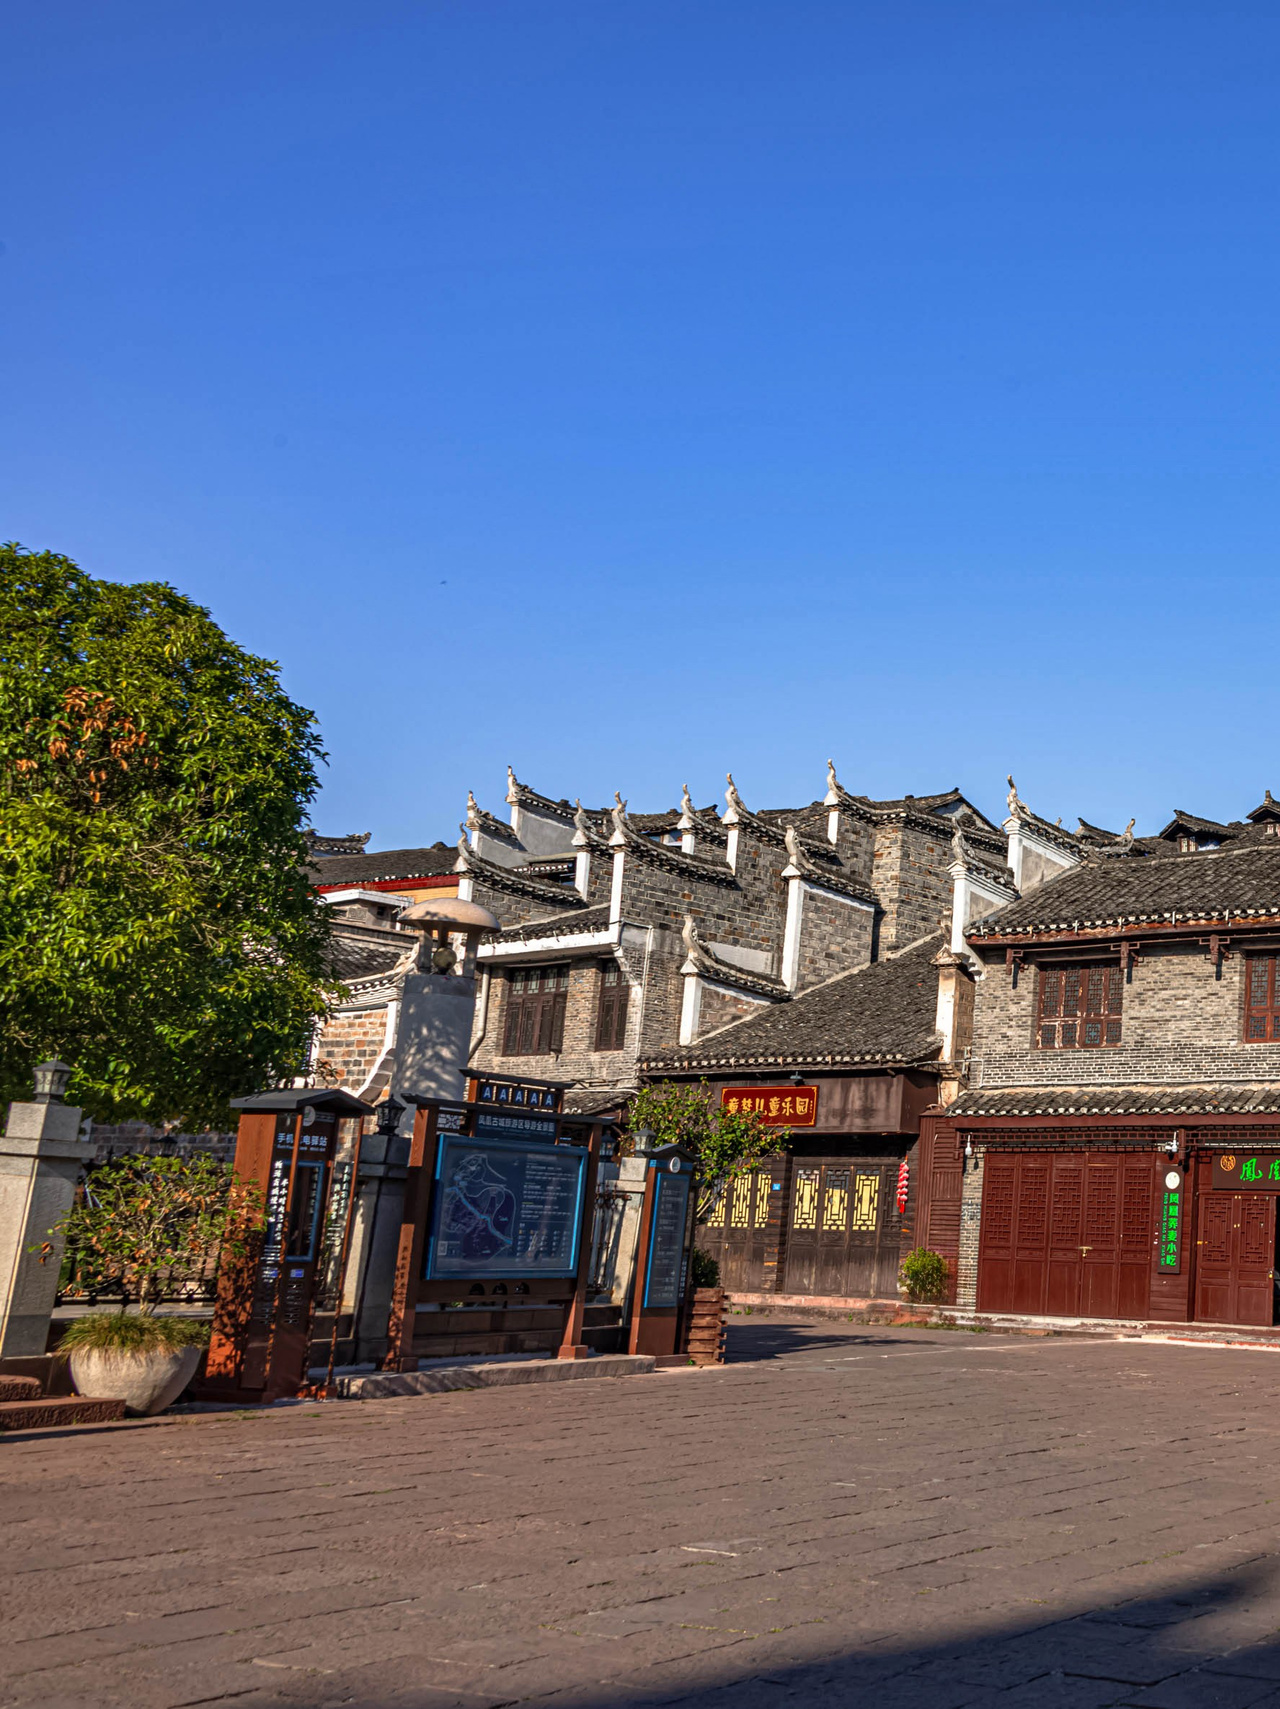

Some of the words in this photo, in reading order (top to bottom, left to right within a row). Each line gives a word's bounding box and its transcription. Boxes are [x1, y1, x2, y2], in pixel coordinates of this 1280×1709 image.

[277, 1132, 328, 1147] 手机电驿站
[1165, 1192, 1179, 1266] 凤凰荞麦小吃
